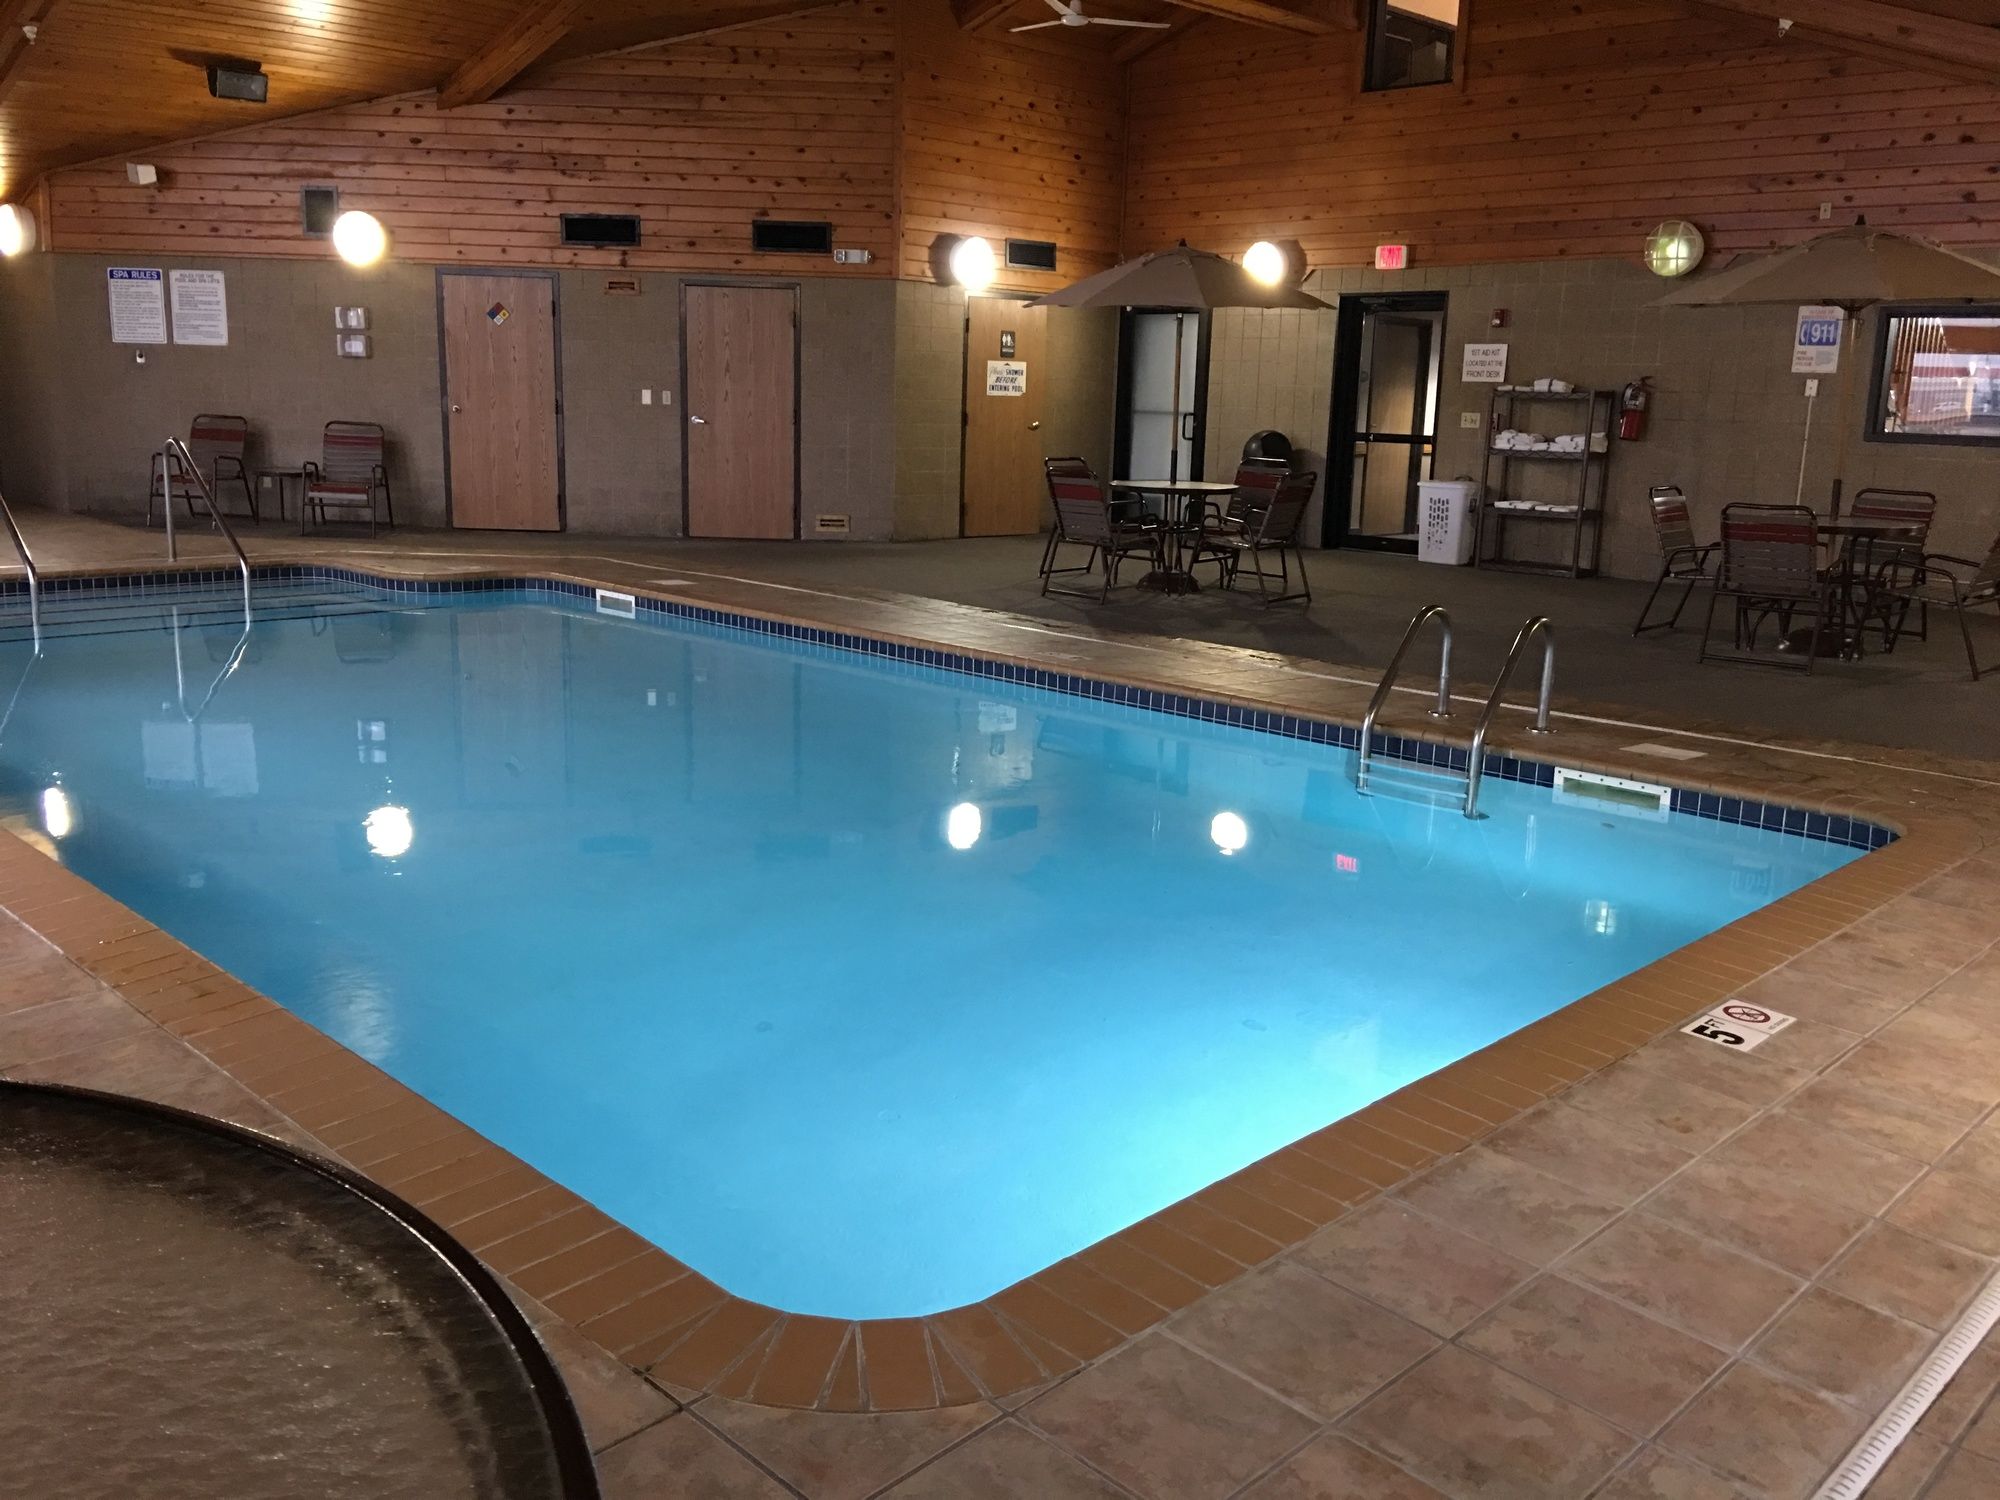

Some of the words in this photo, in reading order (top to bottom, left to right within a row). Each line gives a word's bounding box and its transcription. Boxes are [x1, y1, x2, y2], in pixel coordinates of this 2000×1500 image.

[112, 270, 129, 279] SPA
[131, 271, 158, 280] RULES
[1811, 323, 1836, 343] 911
[1005, 368, 1024, 376] SHOWER
[995, 376, 1018, 384] BEFORE
[1011, 385, 1024, 393] POOL
[1691, 1024, 1746, 1046] 5
